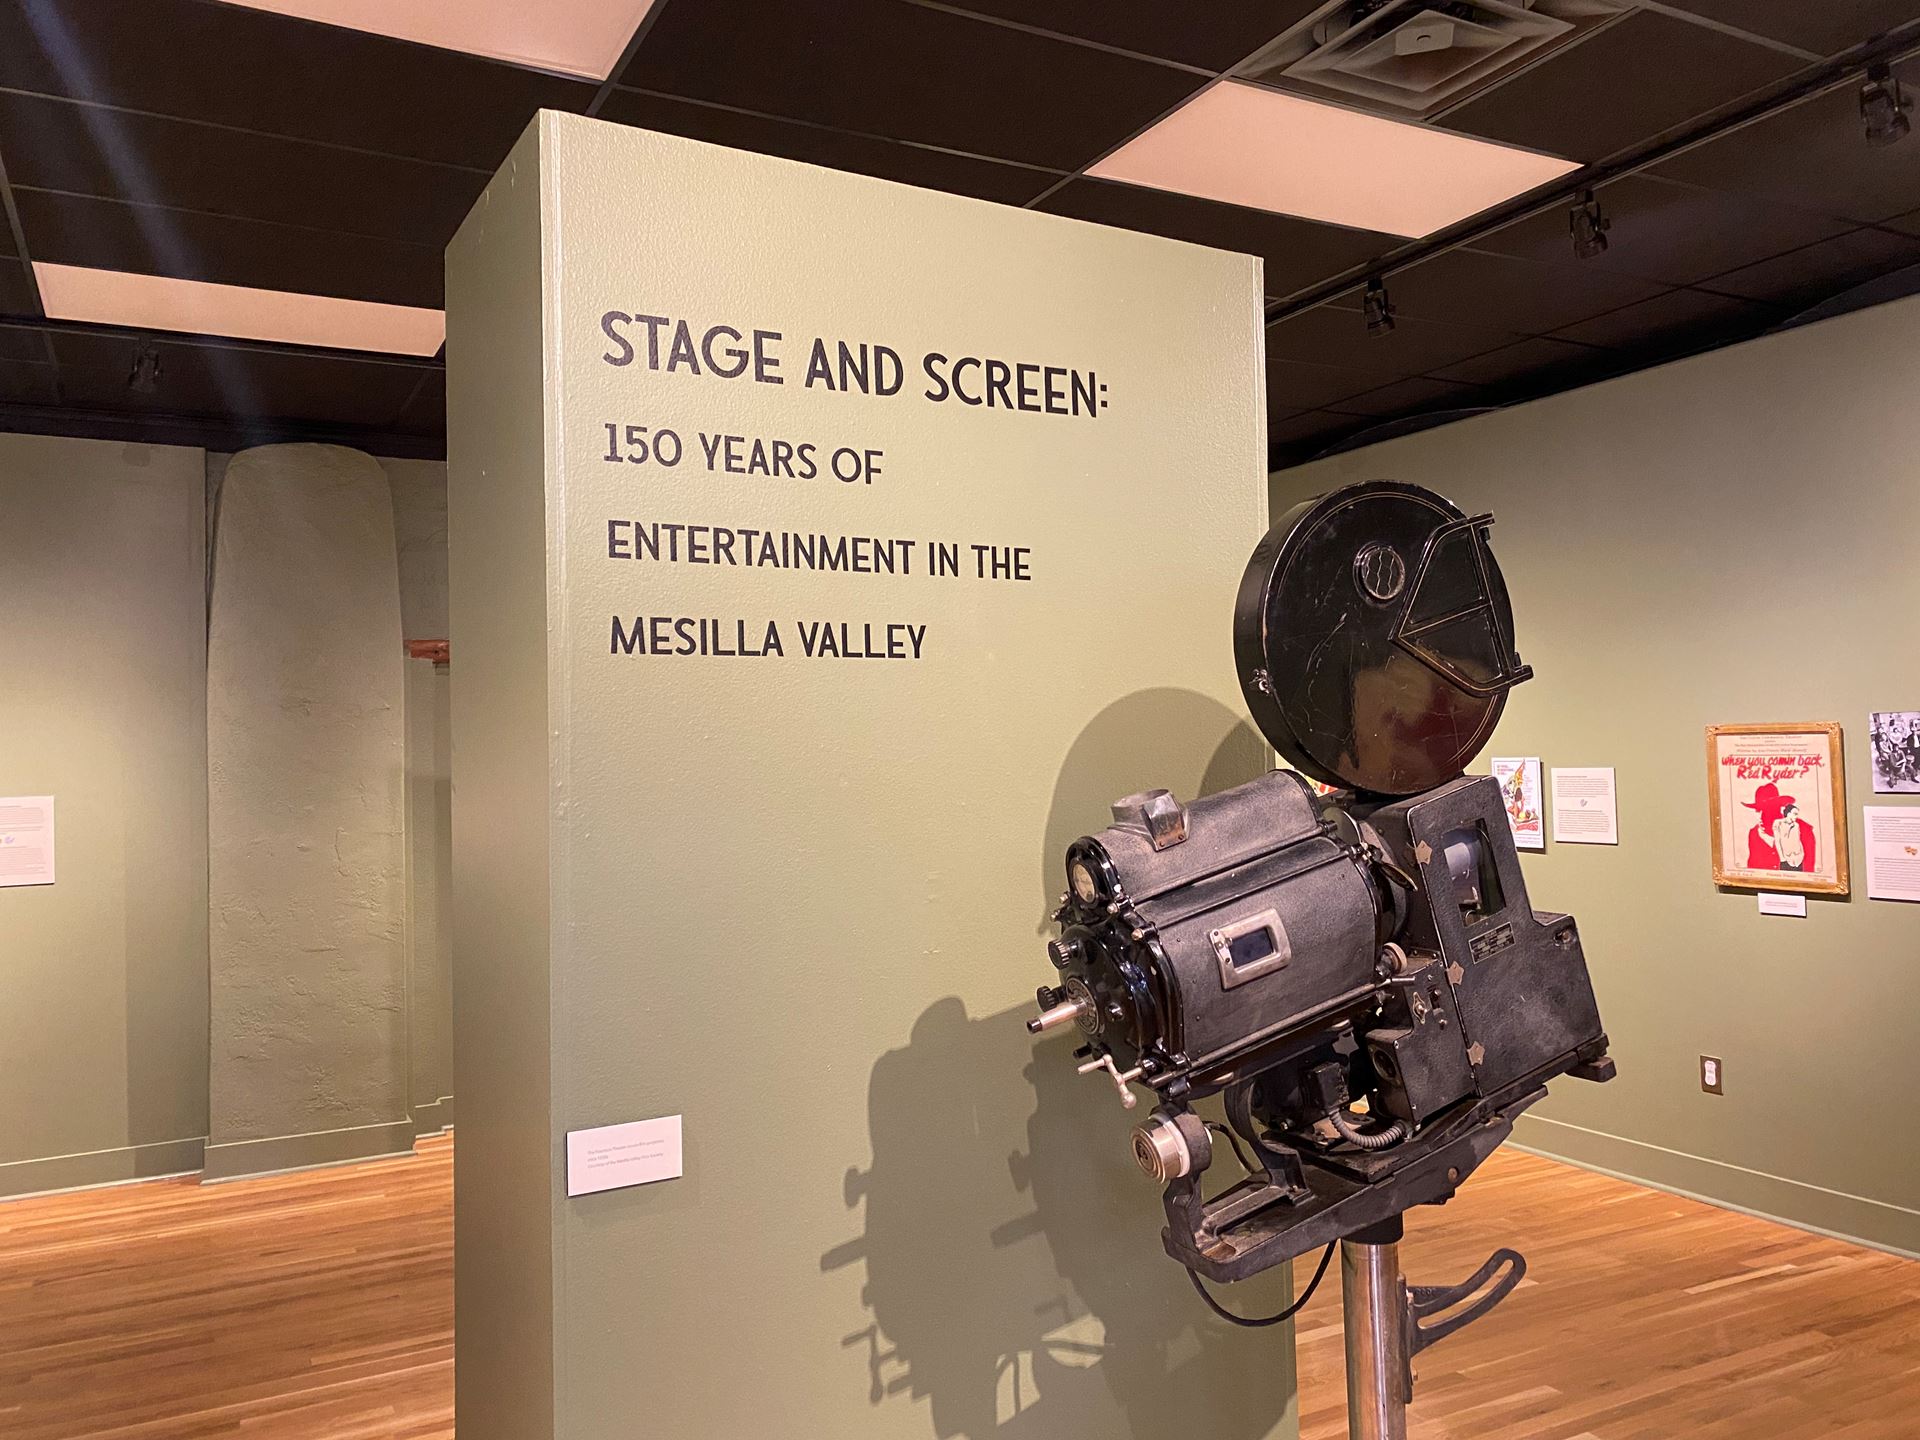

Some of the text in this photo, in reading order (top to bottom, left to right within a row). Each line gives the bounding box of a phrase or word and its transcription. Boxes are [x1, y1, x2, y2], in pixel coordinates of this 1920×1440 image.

[600, 310, 1108, 418] STAGE AND SCREEN:
[603, 423, 884, 485] 150 YEARS OF
[607, 519, 1031, 581] ENTERTAINMENT IN THE
[609, 615, 927, 659] MESILLA VALLEY
[1736, 764, 1810, 783] Red Ryder?
[1747, 757, 1766, 769] you
